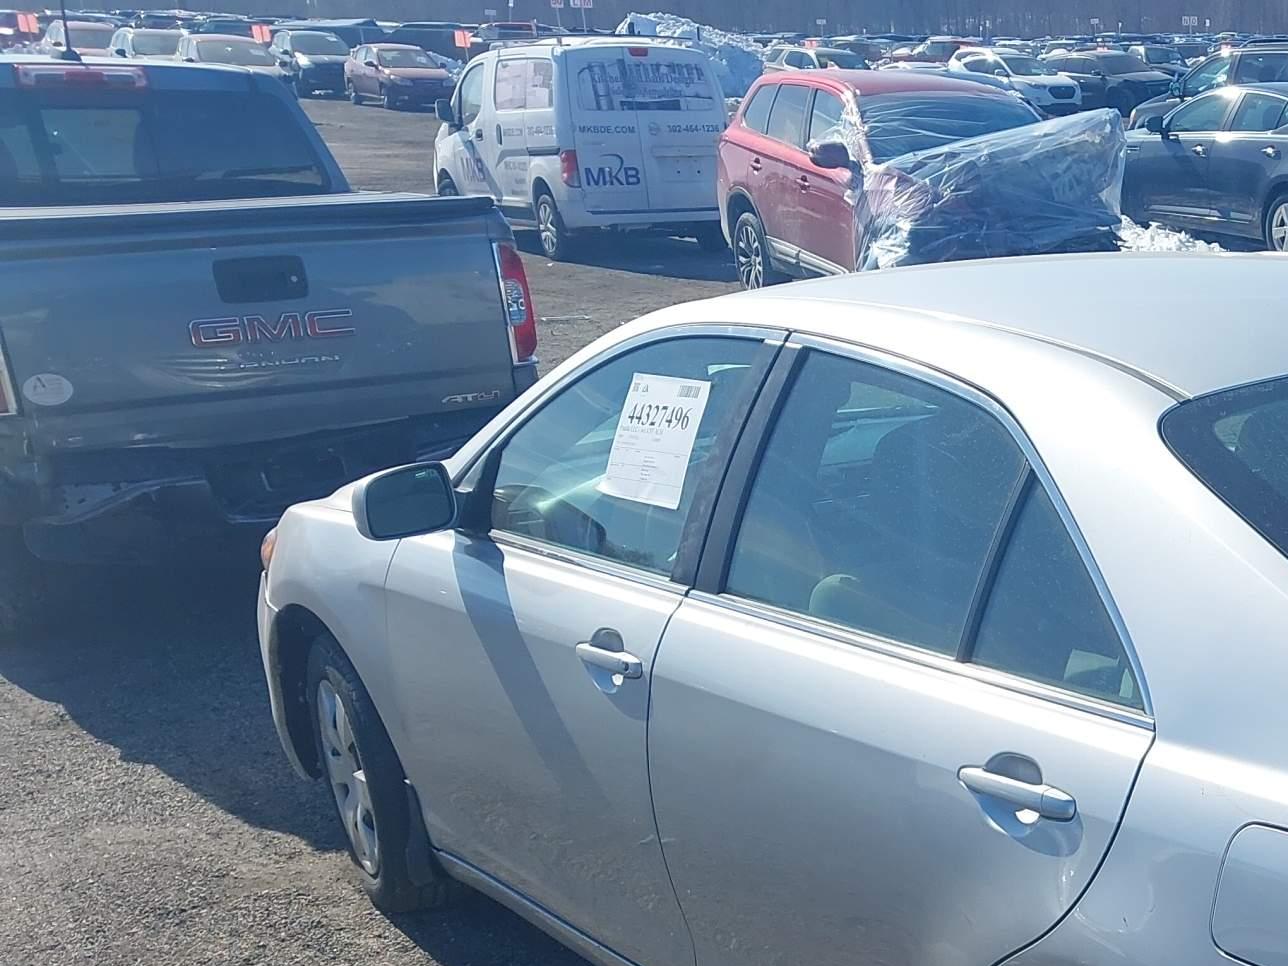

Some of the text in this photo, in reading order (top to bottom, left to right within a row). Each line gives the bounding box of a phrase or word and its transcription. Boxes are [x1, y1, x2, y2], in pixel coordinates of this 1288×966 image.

[584, 154, 641, 186] MKB
[189, 308, 356, 347] GMC
[628, 402, 693, 431] 44327496
